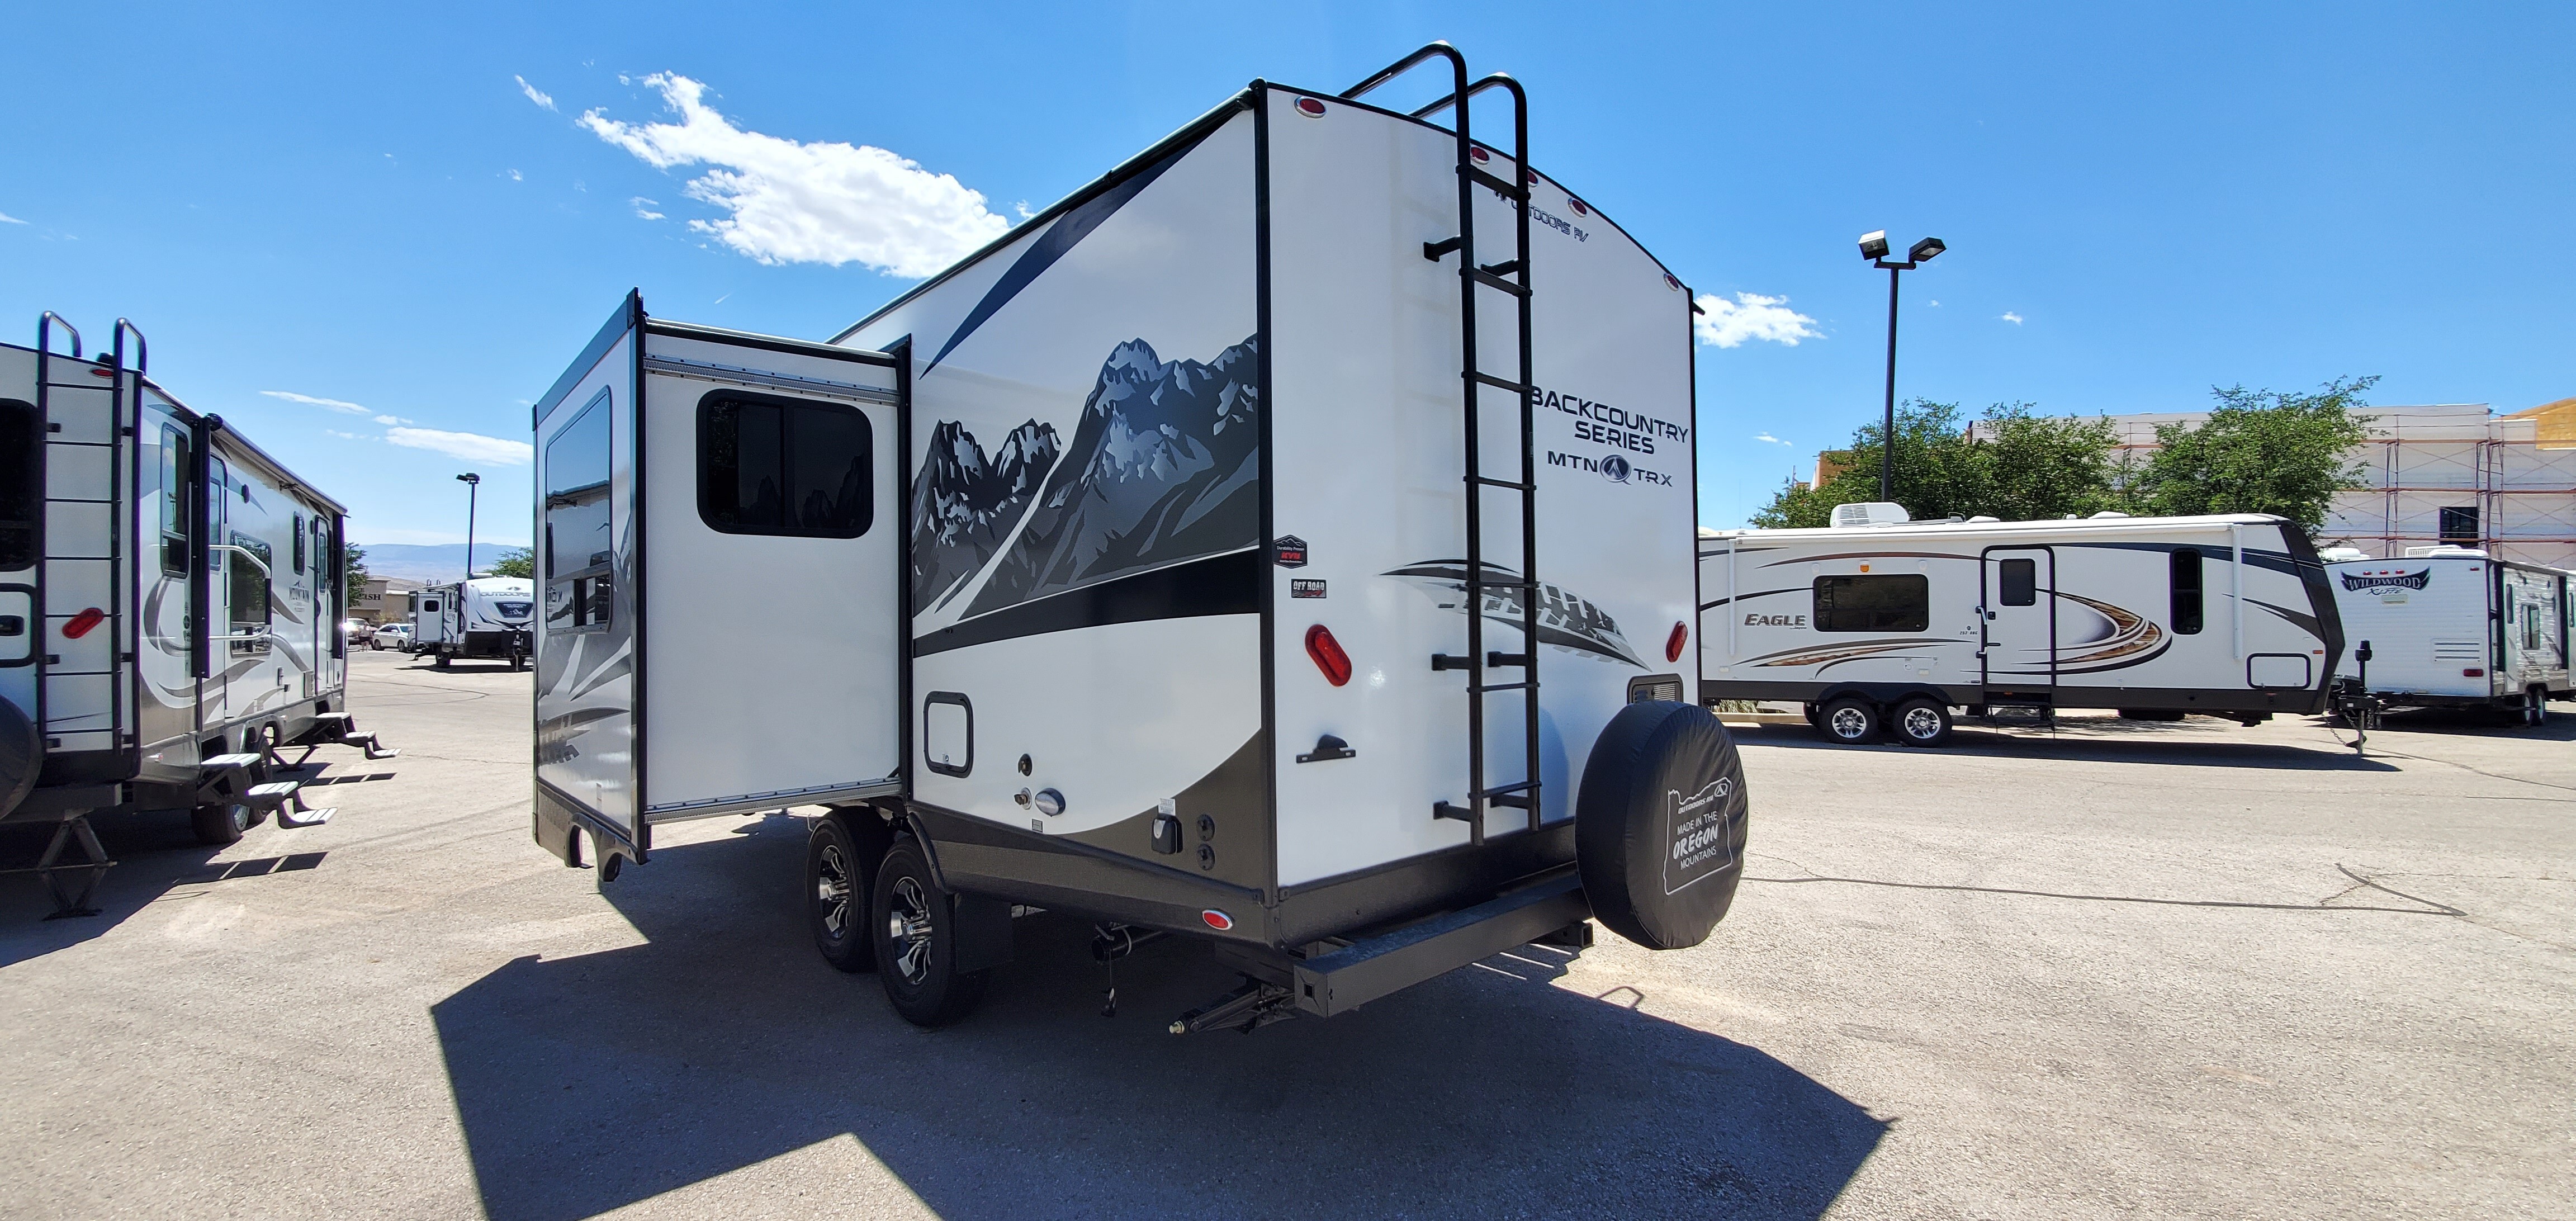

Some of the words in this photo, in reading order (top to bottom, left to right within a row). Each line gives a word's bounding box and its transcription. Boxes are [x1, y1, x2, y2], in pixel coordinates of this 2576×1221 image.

[1574, 226, 1589, 242] RV
[1532, 386, 1689, 443] BACKCOUNTRY
[1574, 420, 1655, 455] SERIES
[1547, 450, 1598, 473] MTN
[1634, 468, 1673, 487] TRX
[1293, 580, 1306, 590] OFF
[1307, 580, 1325, 591] ROAD
[2348, 576, 2421, 591] WILDWOOD
[1744, 613, 1806, 626] EAGLE
[1678, 798, 1706, 815] OUTDOORS
[1677, 820, 1694, 836] MADE
[1696, 816, 1702, 827] IN
[1703, 811, 1718, 824] THE
[1673, 824, 1718, 860] OREGON
[1680, 845, 1717, 870] MOUNTAINS
